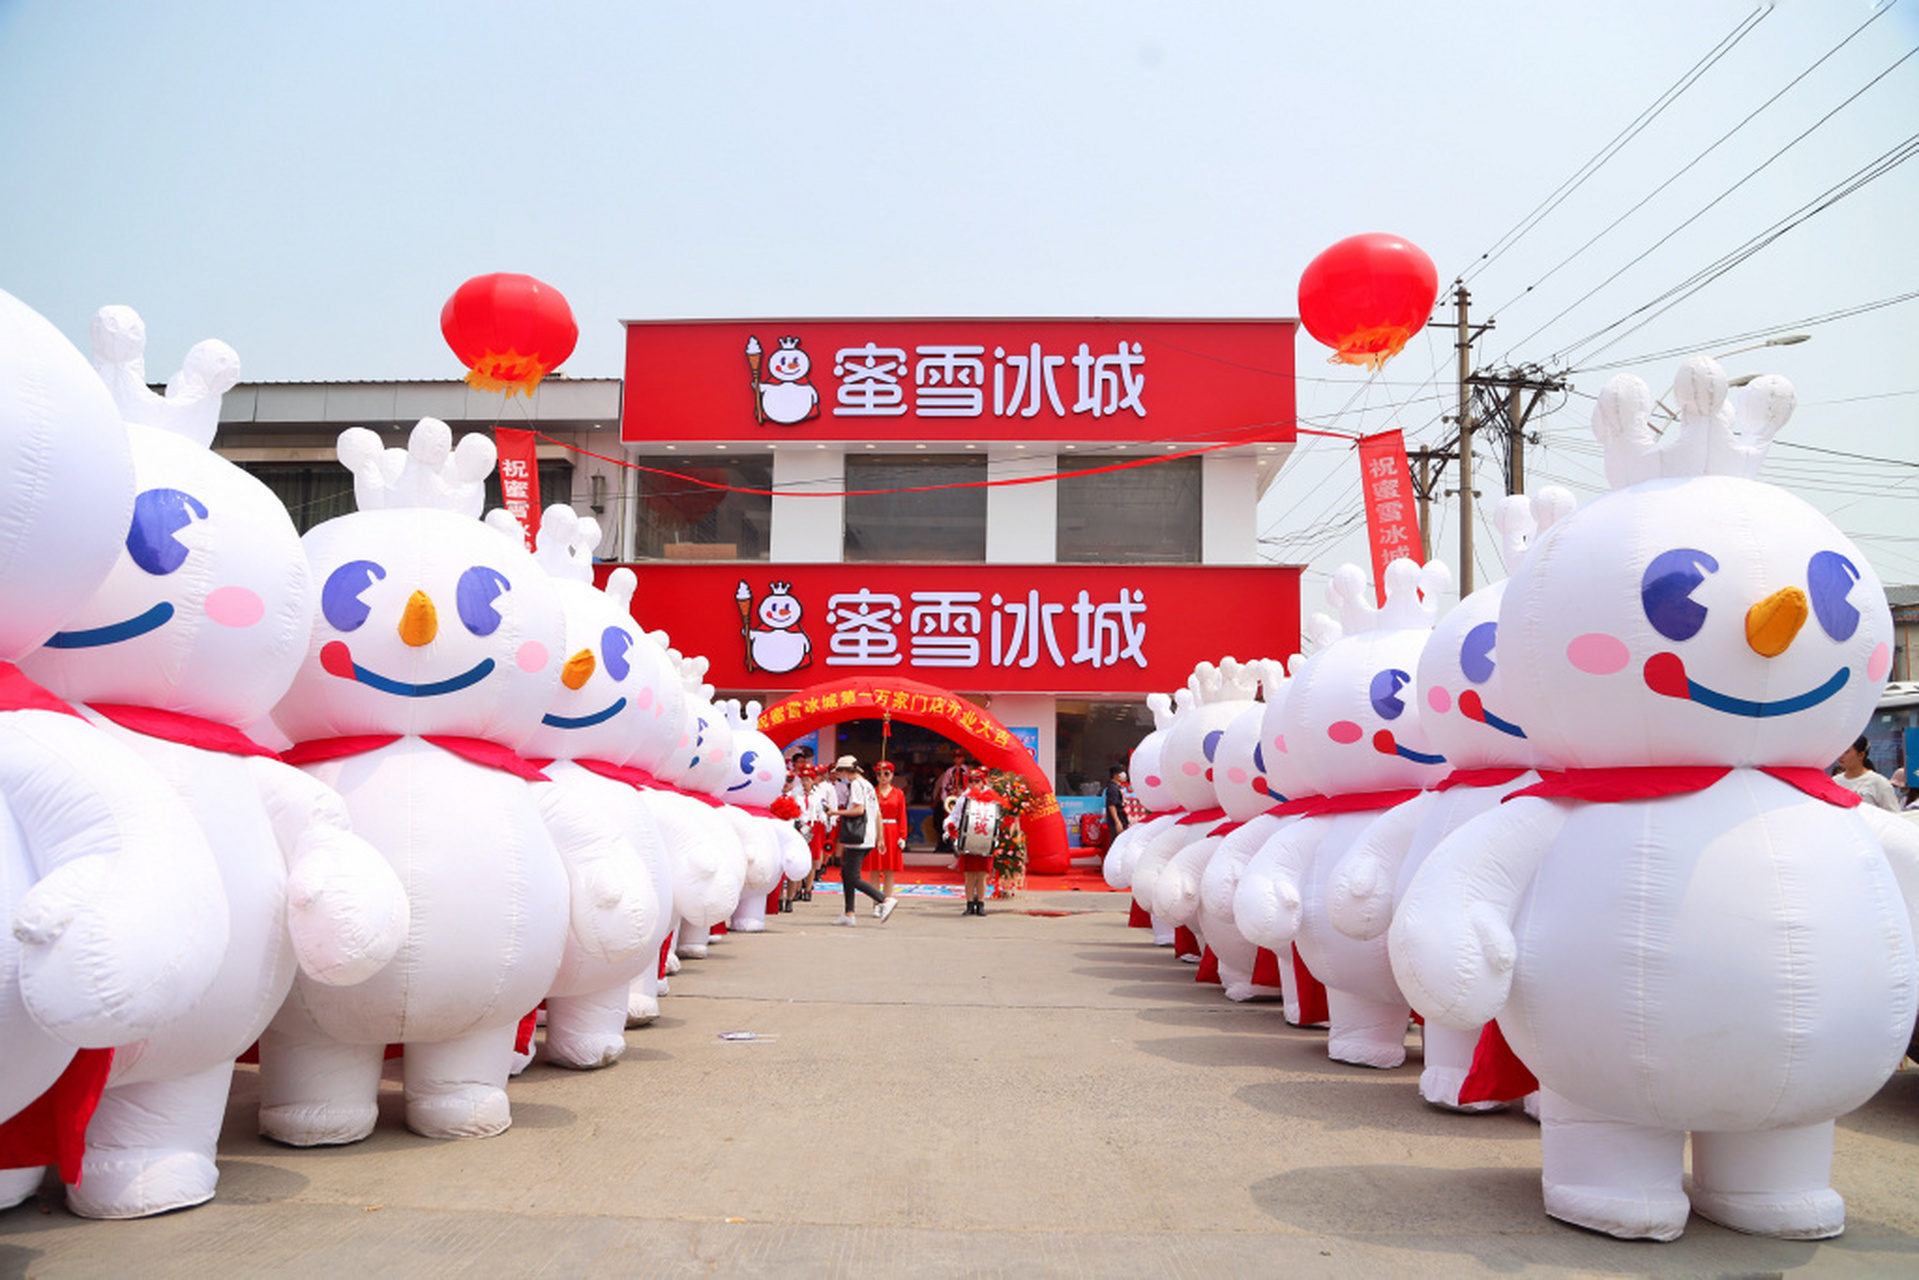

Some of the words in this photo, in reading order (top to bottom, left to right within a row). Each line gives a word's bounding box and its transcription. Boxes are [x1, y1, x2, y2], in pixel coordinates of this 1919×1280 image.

[833, 342, 1147, 418] 蜜雪冰城
[502, 459, 532, 550] 祝蜜雪
[826, 587, 1148, 669] 蜜雪冰城
